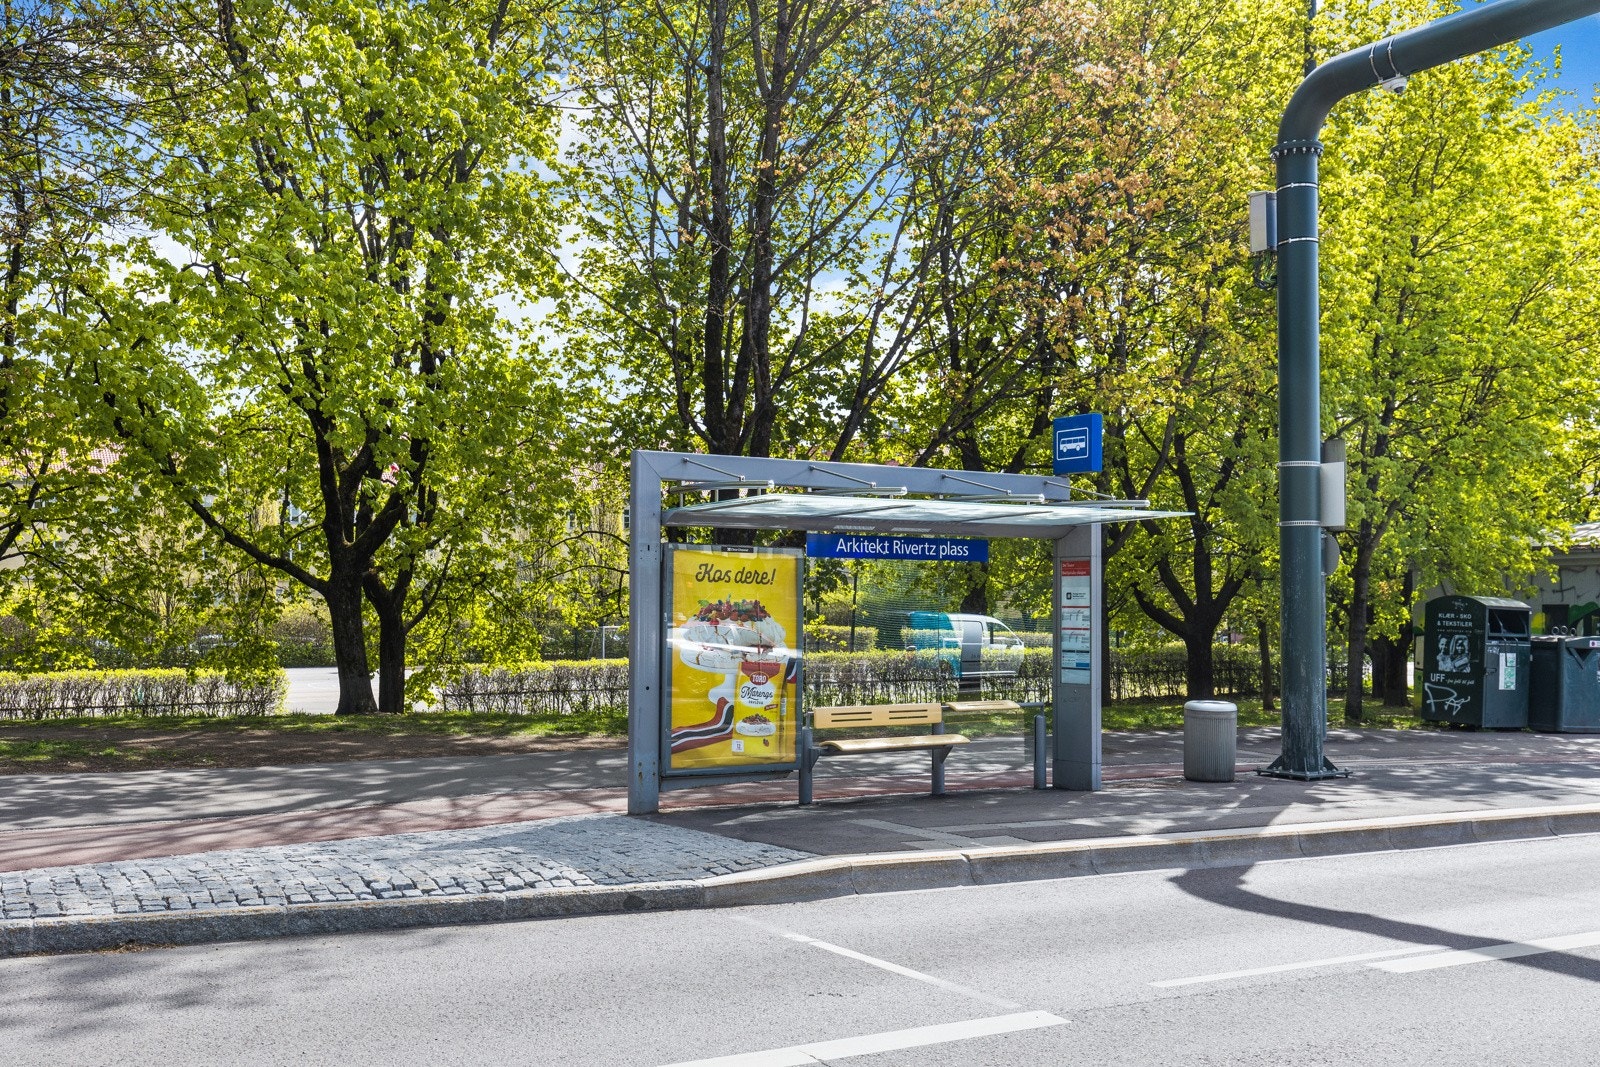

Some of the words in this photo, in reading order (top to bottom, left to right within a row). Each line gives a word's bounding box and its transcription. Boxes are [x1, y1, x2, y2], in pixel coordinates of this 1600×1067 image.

[836, 536, 890, 555] Arkitekt
[893, 539, 936, 556] Rivertz
[939, 540, 969, 559] plass
[695, 563, 732, 583] Kos
[734, 566, 776, 586] dere!
[1430, 672, 1446, 682] UFF
[741, 686, 773, 700] Marengs
